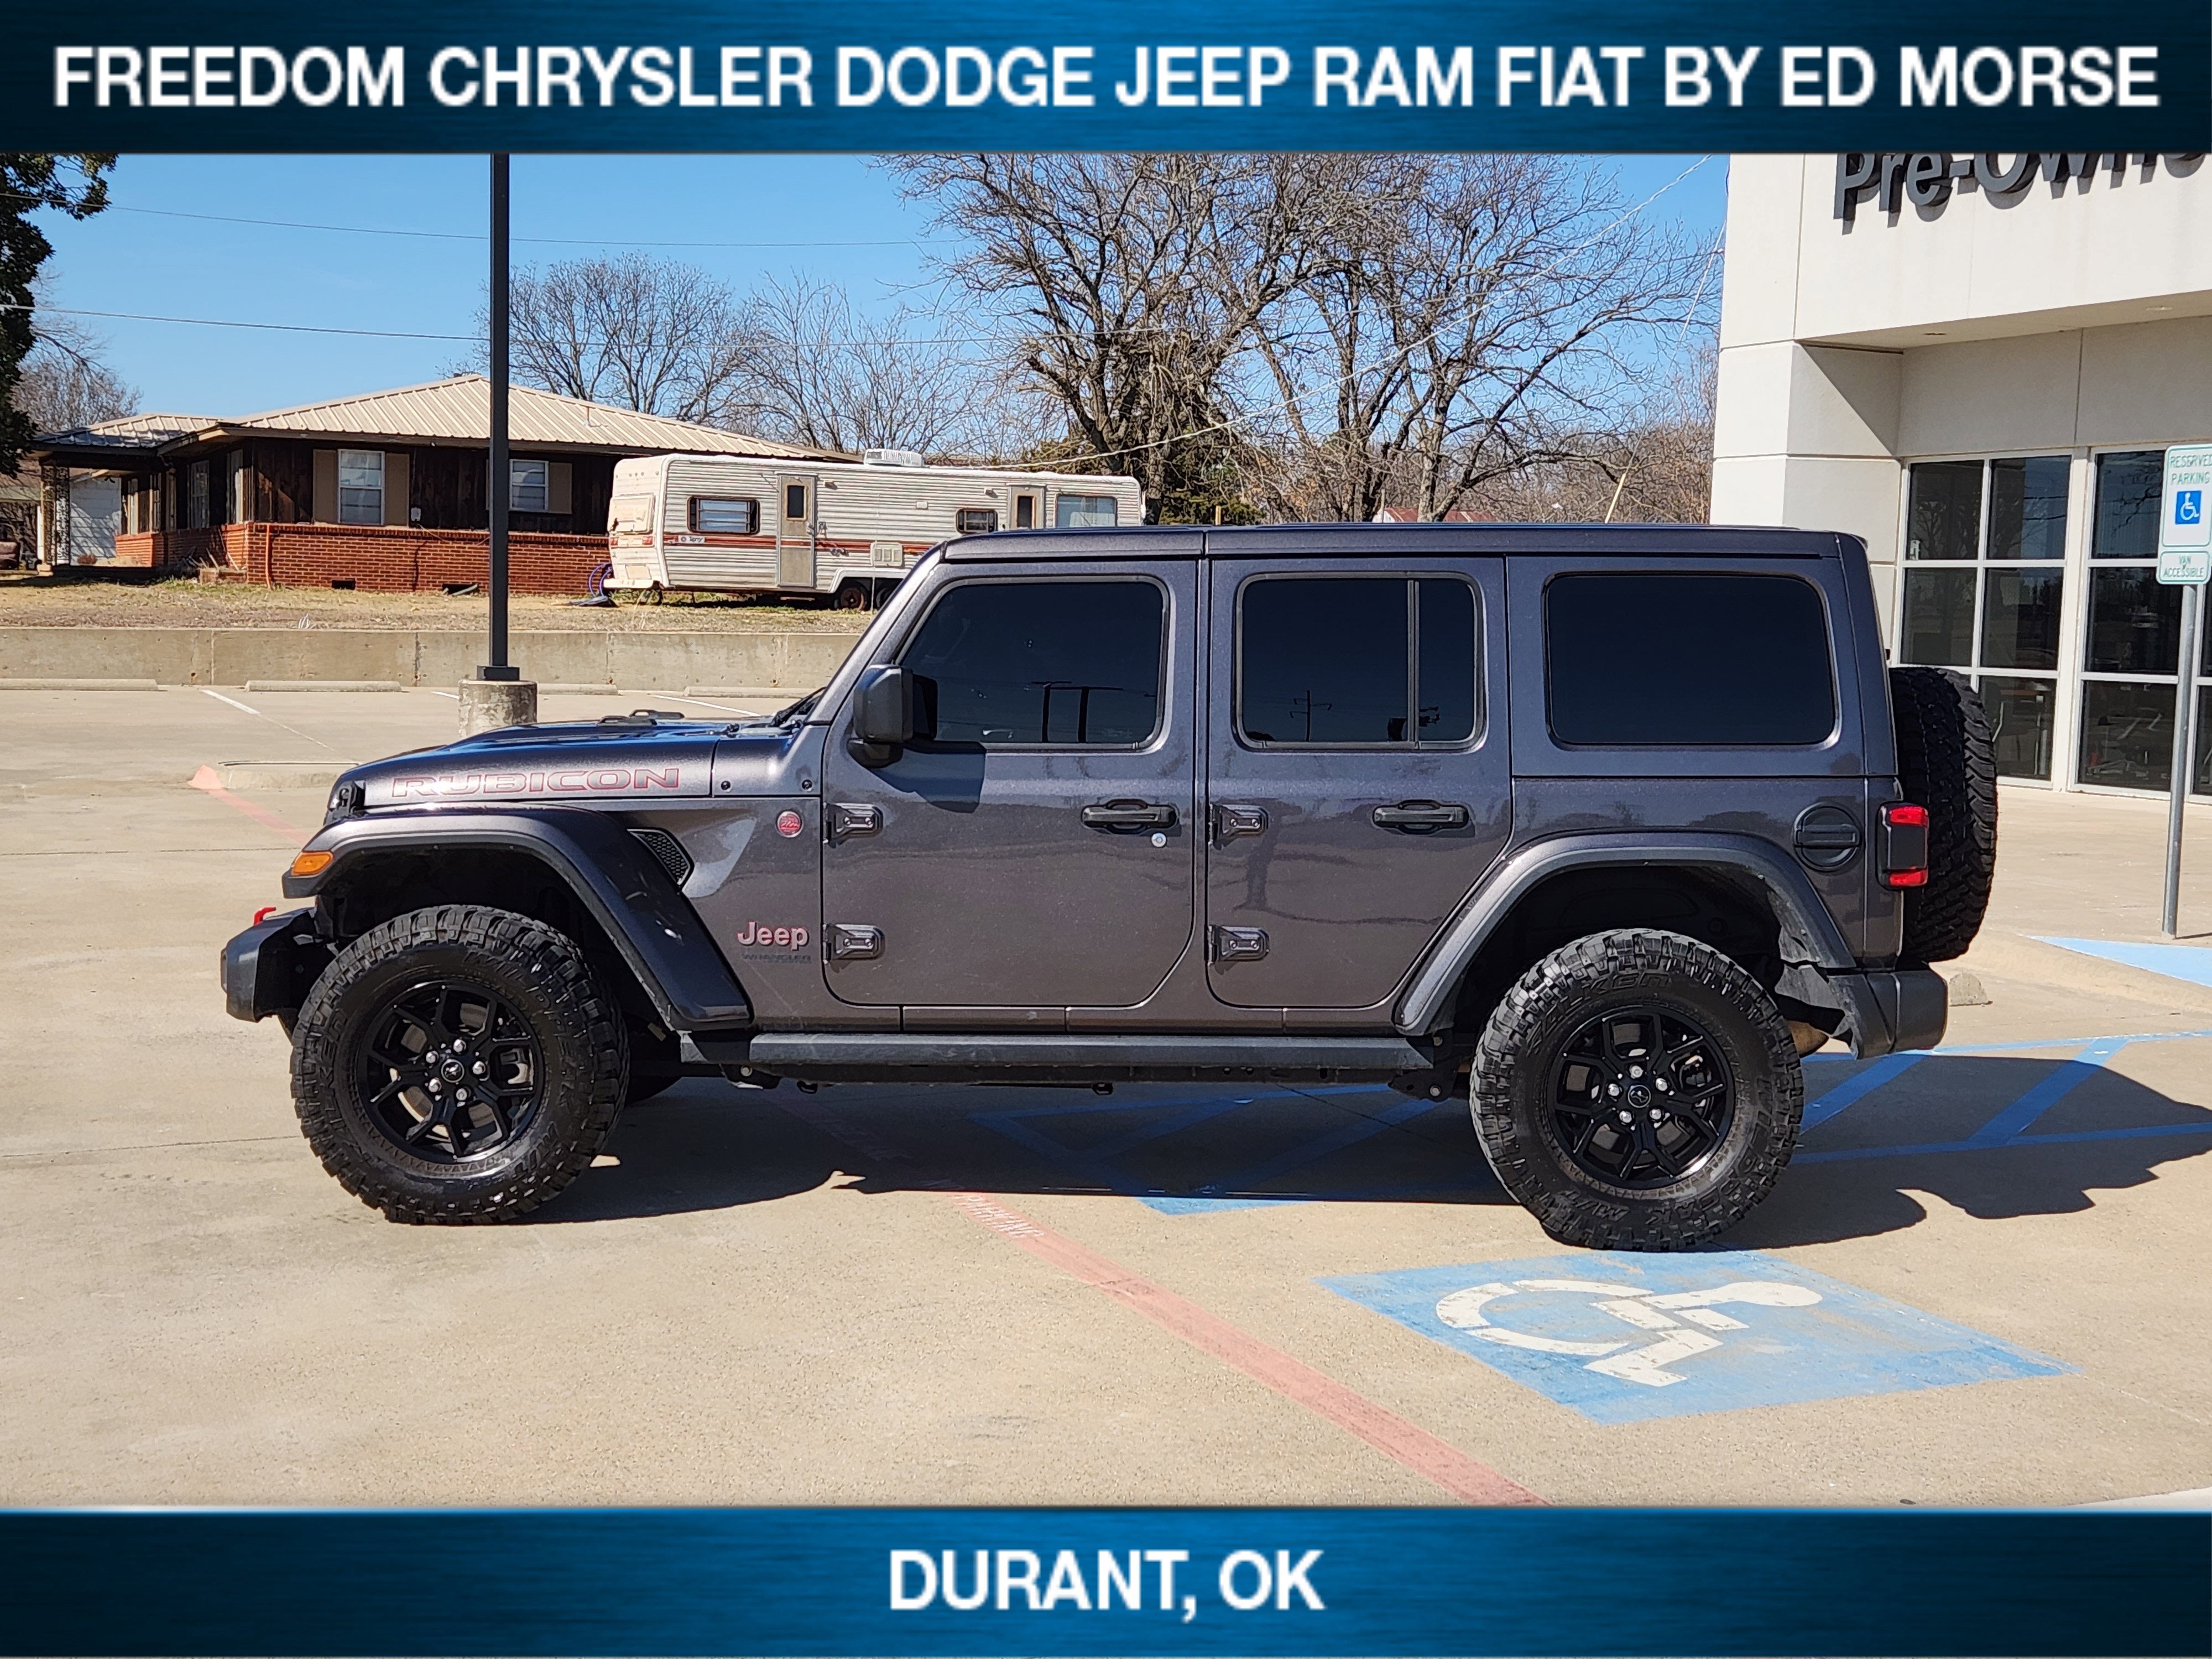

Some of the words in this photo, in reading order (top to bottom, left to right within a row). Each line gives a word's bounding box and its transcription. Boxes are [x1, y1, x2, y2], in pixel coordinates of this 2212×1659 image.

[2171, 472, 2210, 485] PARKING
[2179, 555, 2191, 564] VAN
[2163, 567, 2204, 577] ACCESSIBLE
[392, 768, 679, 797] RUBICON
[737, 920, 810, 951] Jeep
